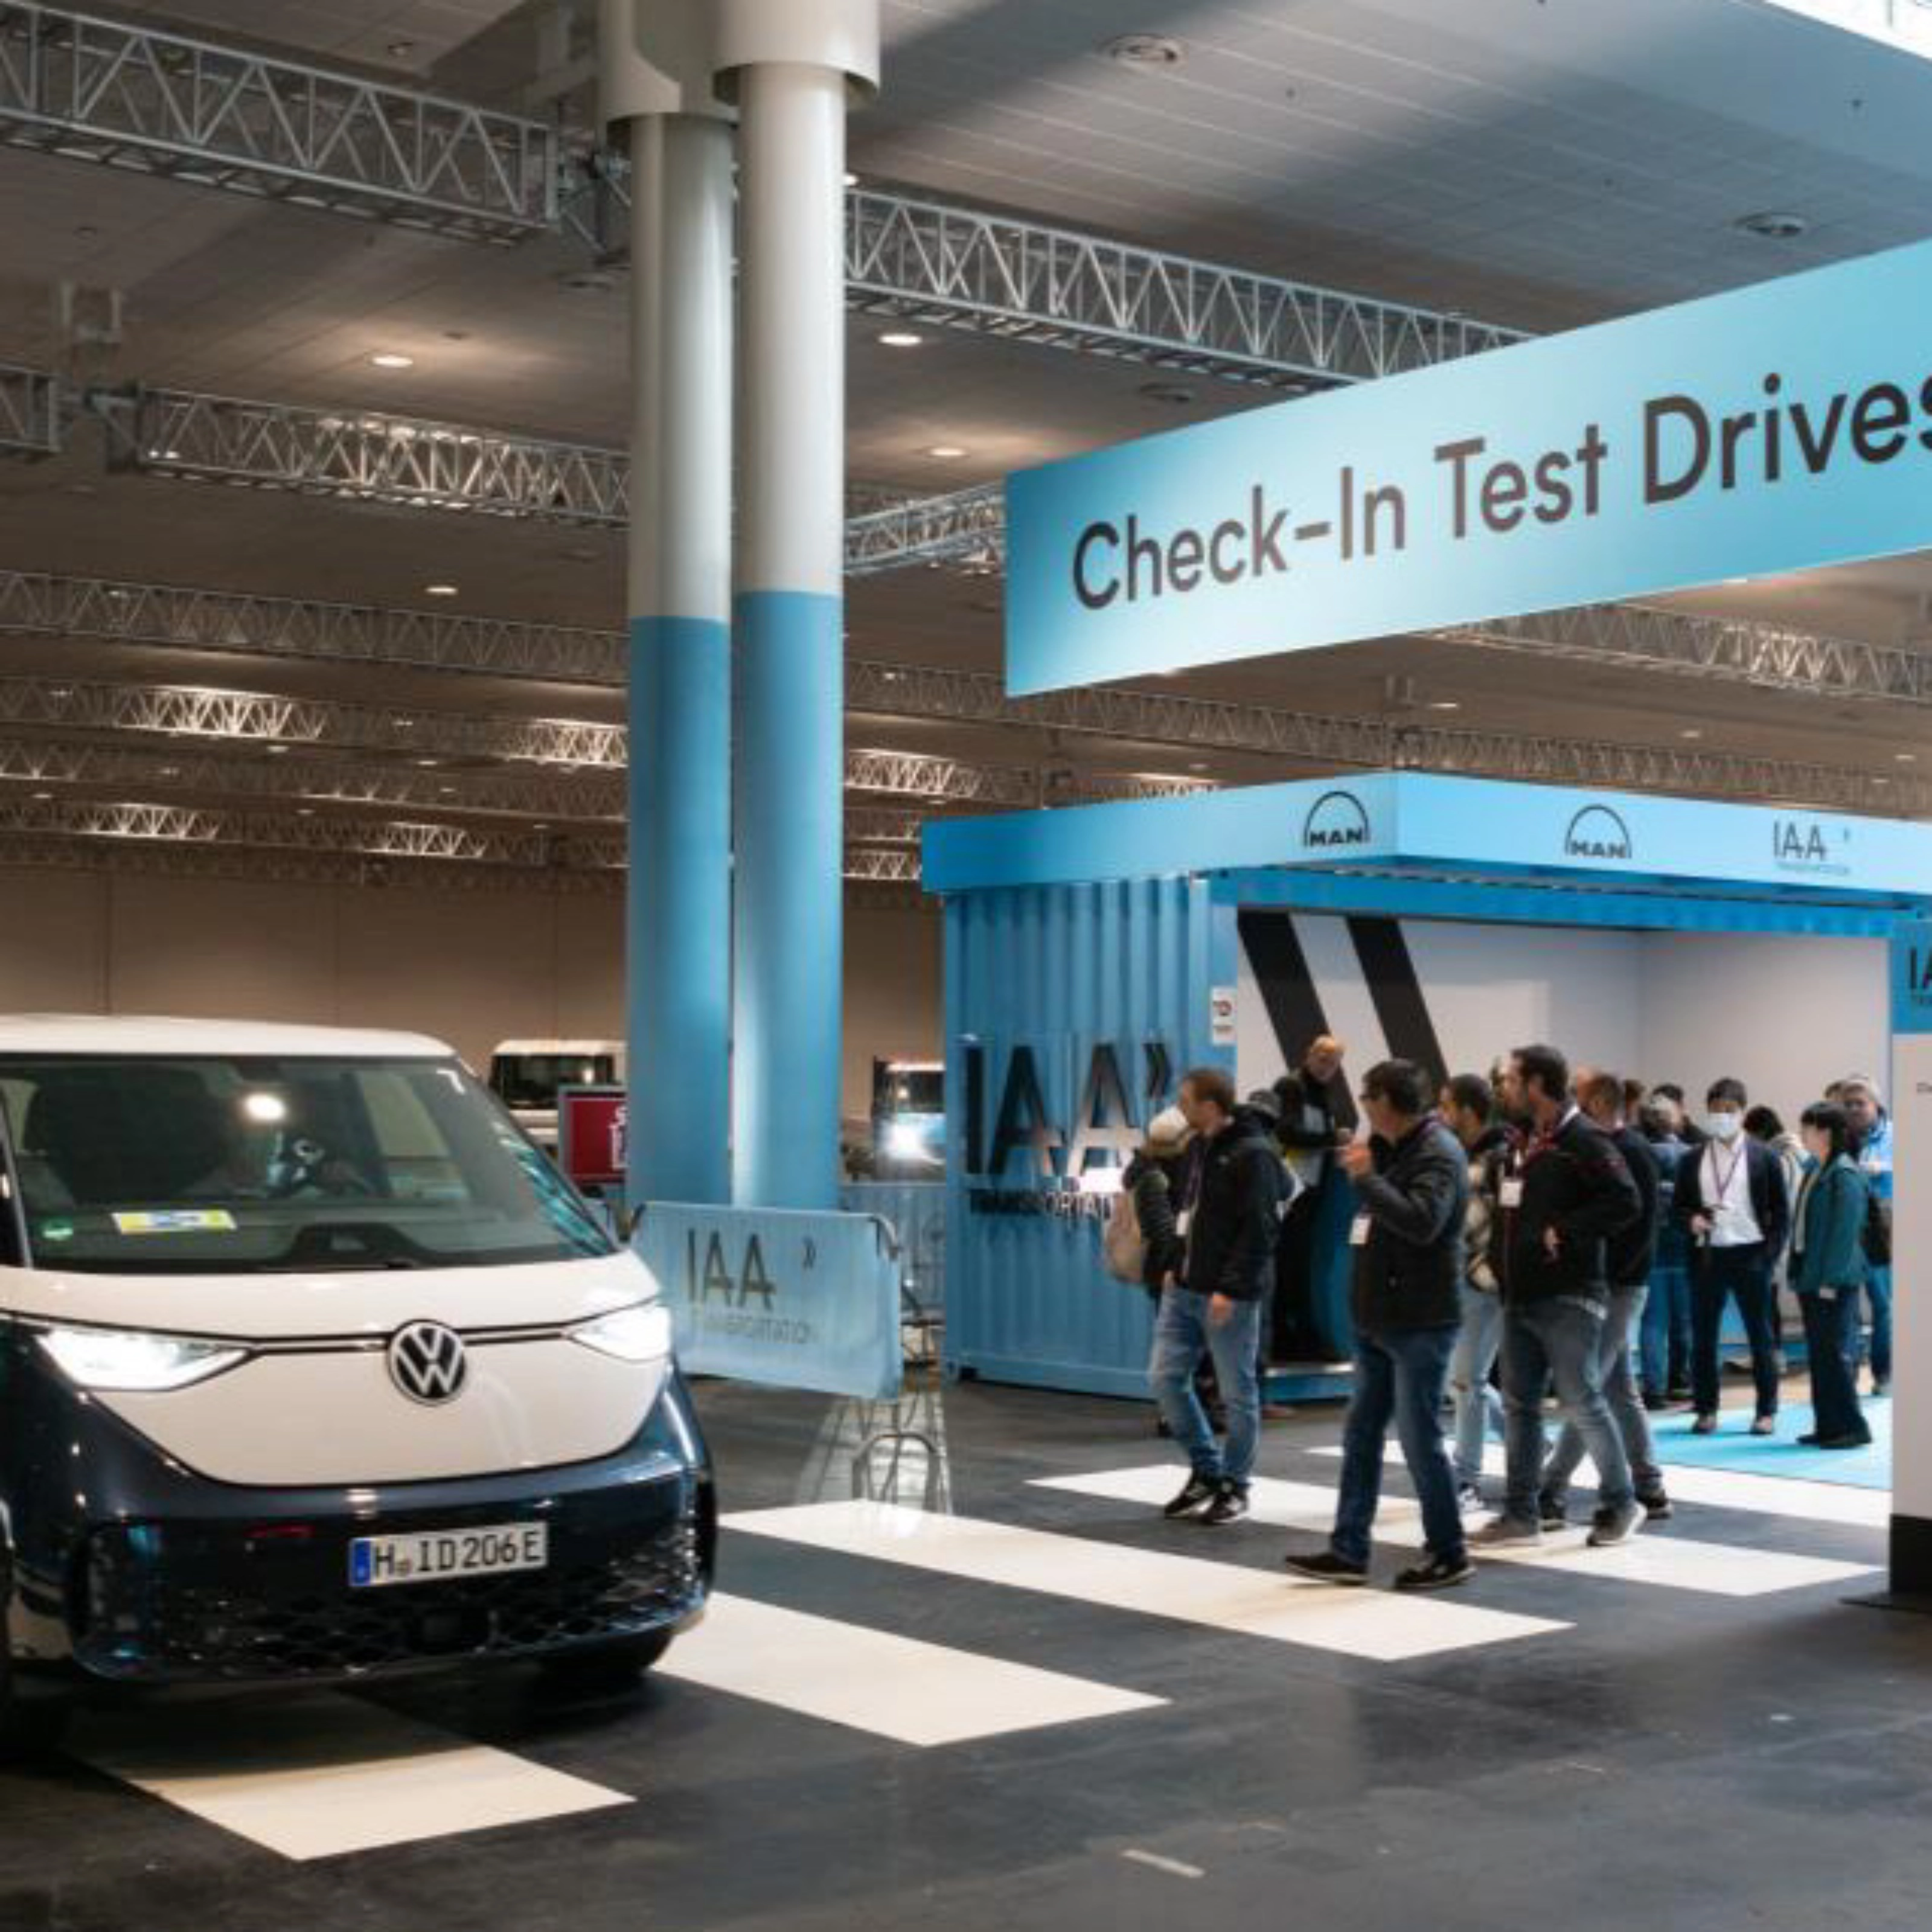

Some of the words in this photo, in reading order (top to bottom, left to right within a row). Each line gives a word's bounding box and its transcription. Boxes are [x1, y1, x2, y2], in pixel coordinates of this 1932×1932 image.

[1072, 465, 1406, 610] Check-In
[1434, 424, 1608, 539] Test
[1310, 828, 1363, 846] MAN
[1570, 840, 1626, 858] MAN
[1773, 821, 1826, 861] IAA
[965, 1044, 1144, 1177] IAA
[688, 1228, 777, 1311] IAA
